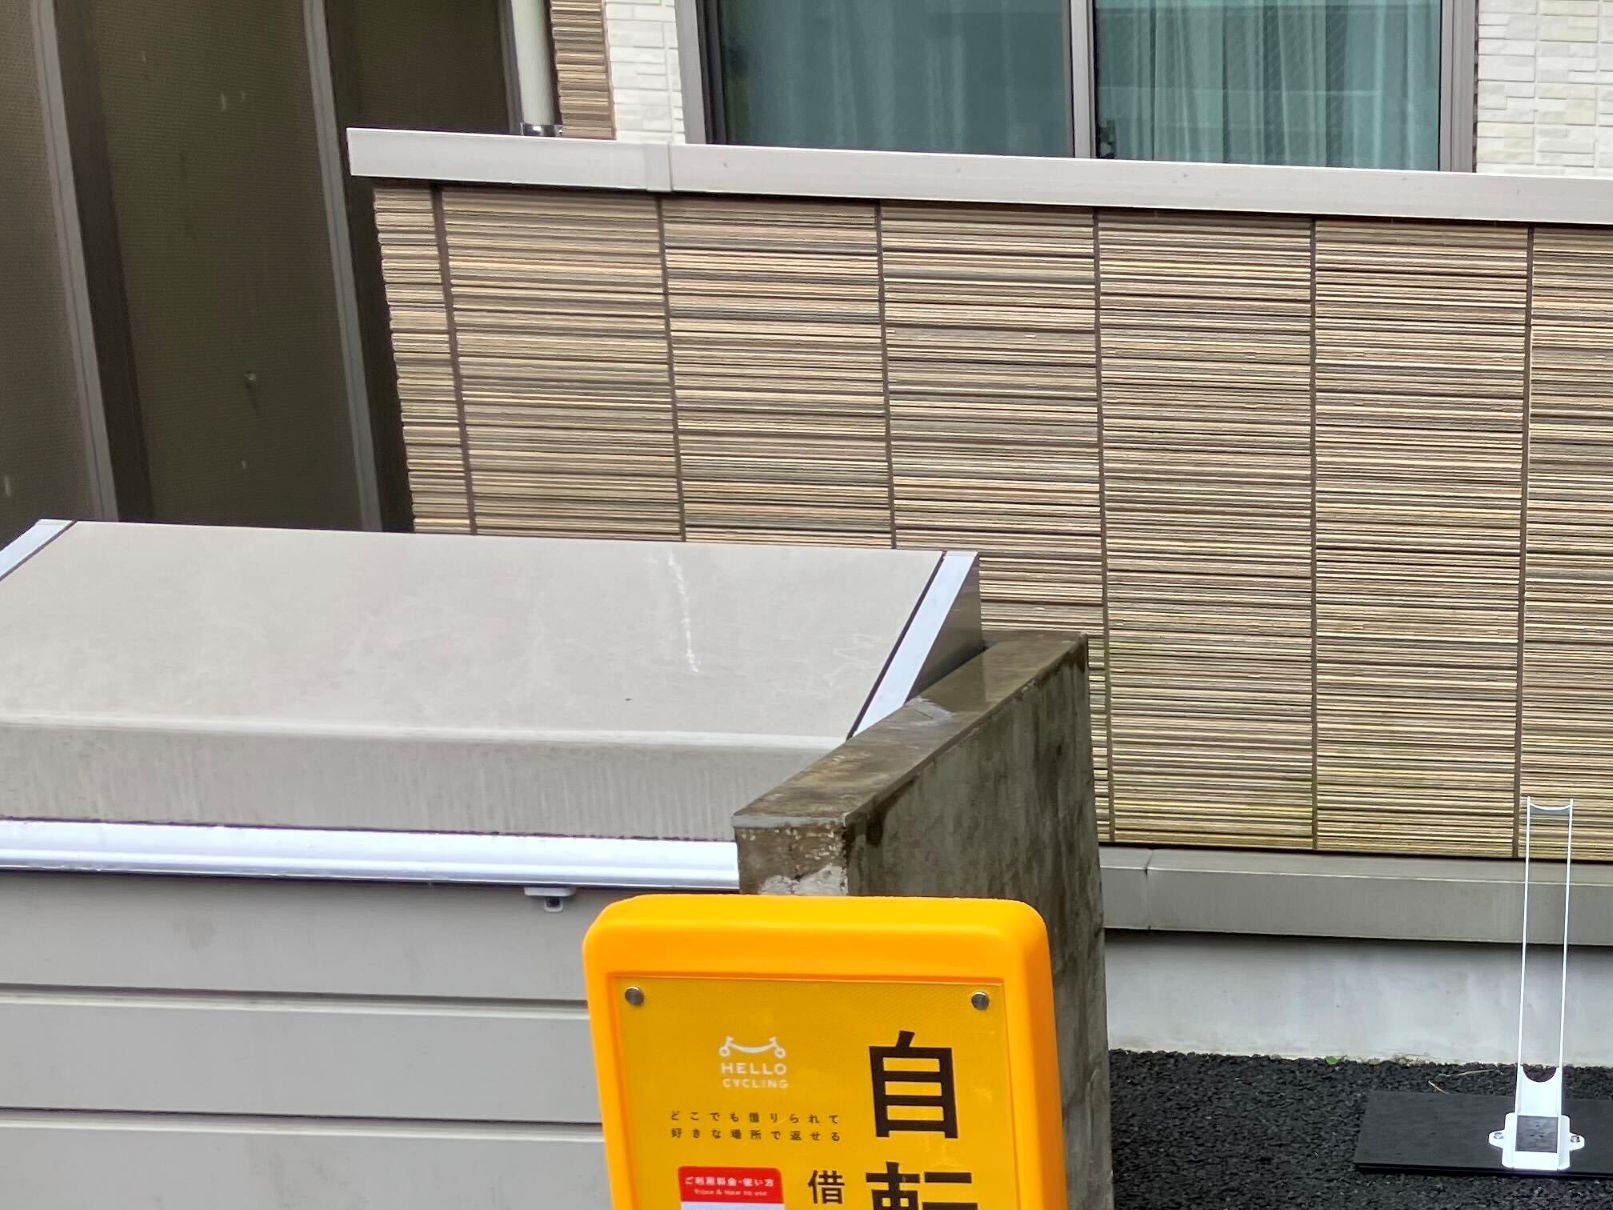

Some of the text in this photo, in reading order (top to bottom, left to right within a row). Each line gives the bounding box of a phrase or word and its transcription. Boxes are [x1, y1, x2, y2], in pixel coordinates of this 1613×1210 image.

[720, 1062, 788, 1075] HELLO
[722, 1077, 789, 1089] CYCLING
[670, 1110, 840, 1124] どこでも借りられて
[671, 1127, 841, 1142] 好きな場所で返せる
